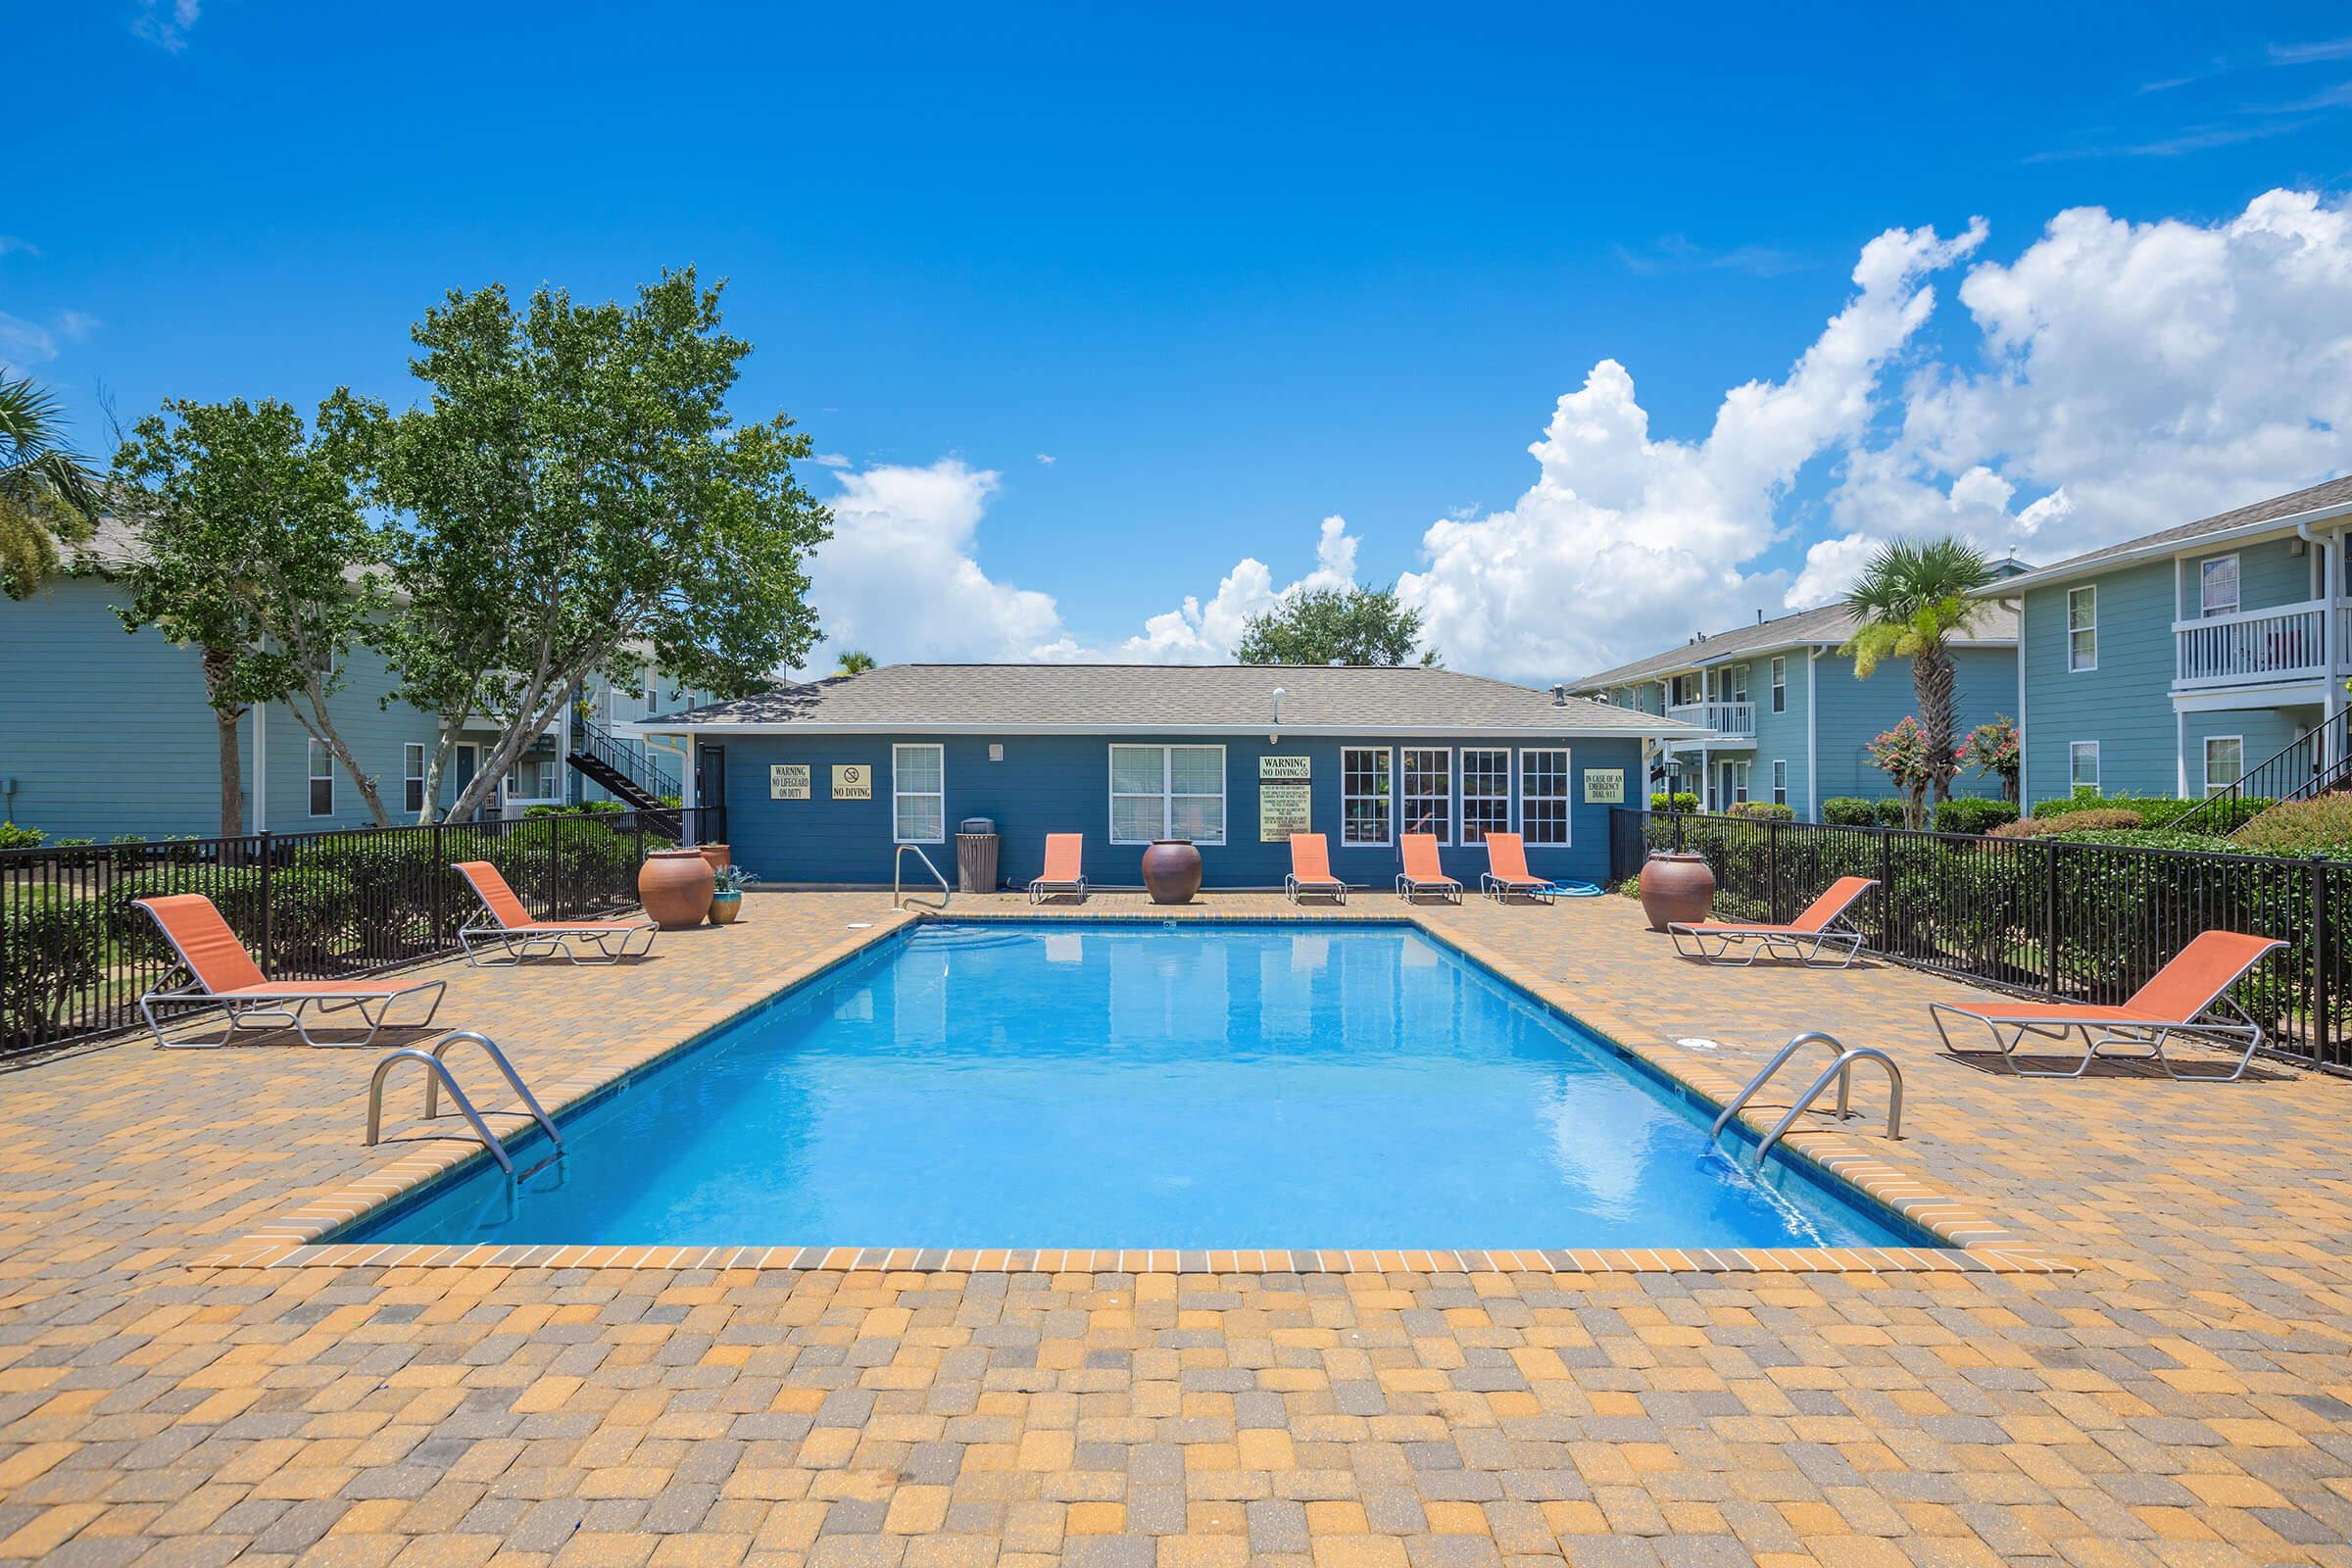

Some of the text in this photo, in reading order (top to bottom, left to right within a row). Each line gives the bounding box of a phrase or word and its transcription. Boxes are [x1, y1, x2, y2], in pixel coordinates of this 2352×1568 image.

[1264, 758, 1306, 767] WARNING
[775, 766, 806, 776] WARNING
[1262, 768, 1299, 777] NO DIVING
[772, 777, 808, 787] NO LIFEGUARD
[779, 788, 802, 798] ON DUTY
[834, 788, 870, 797] NO DIVING
